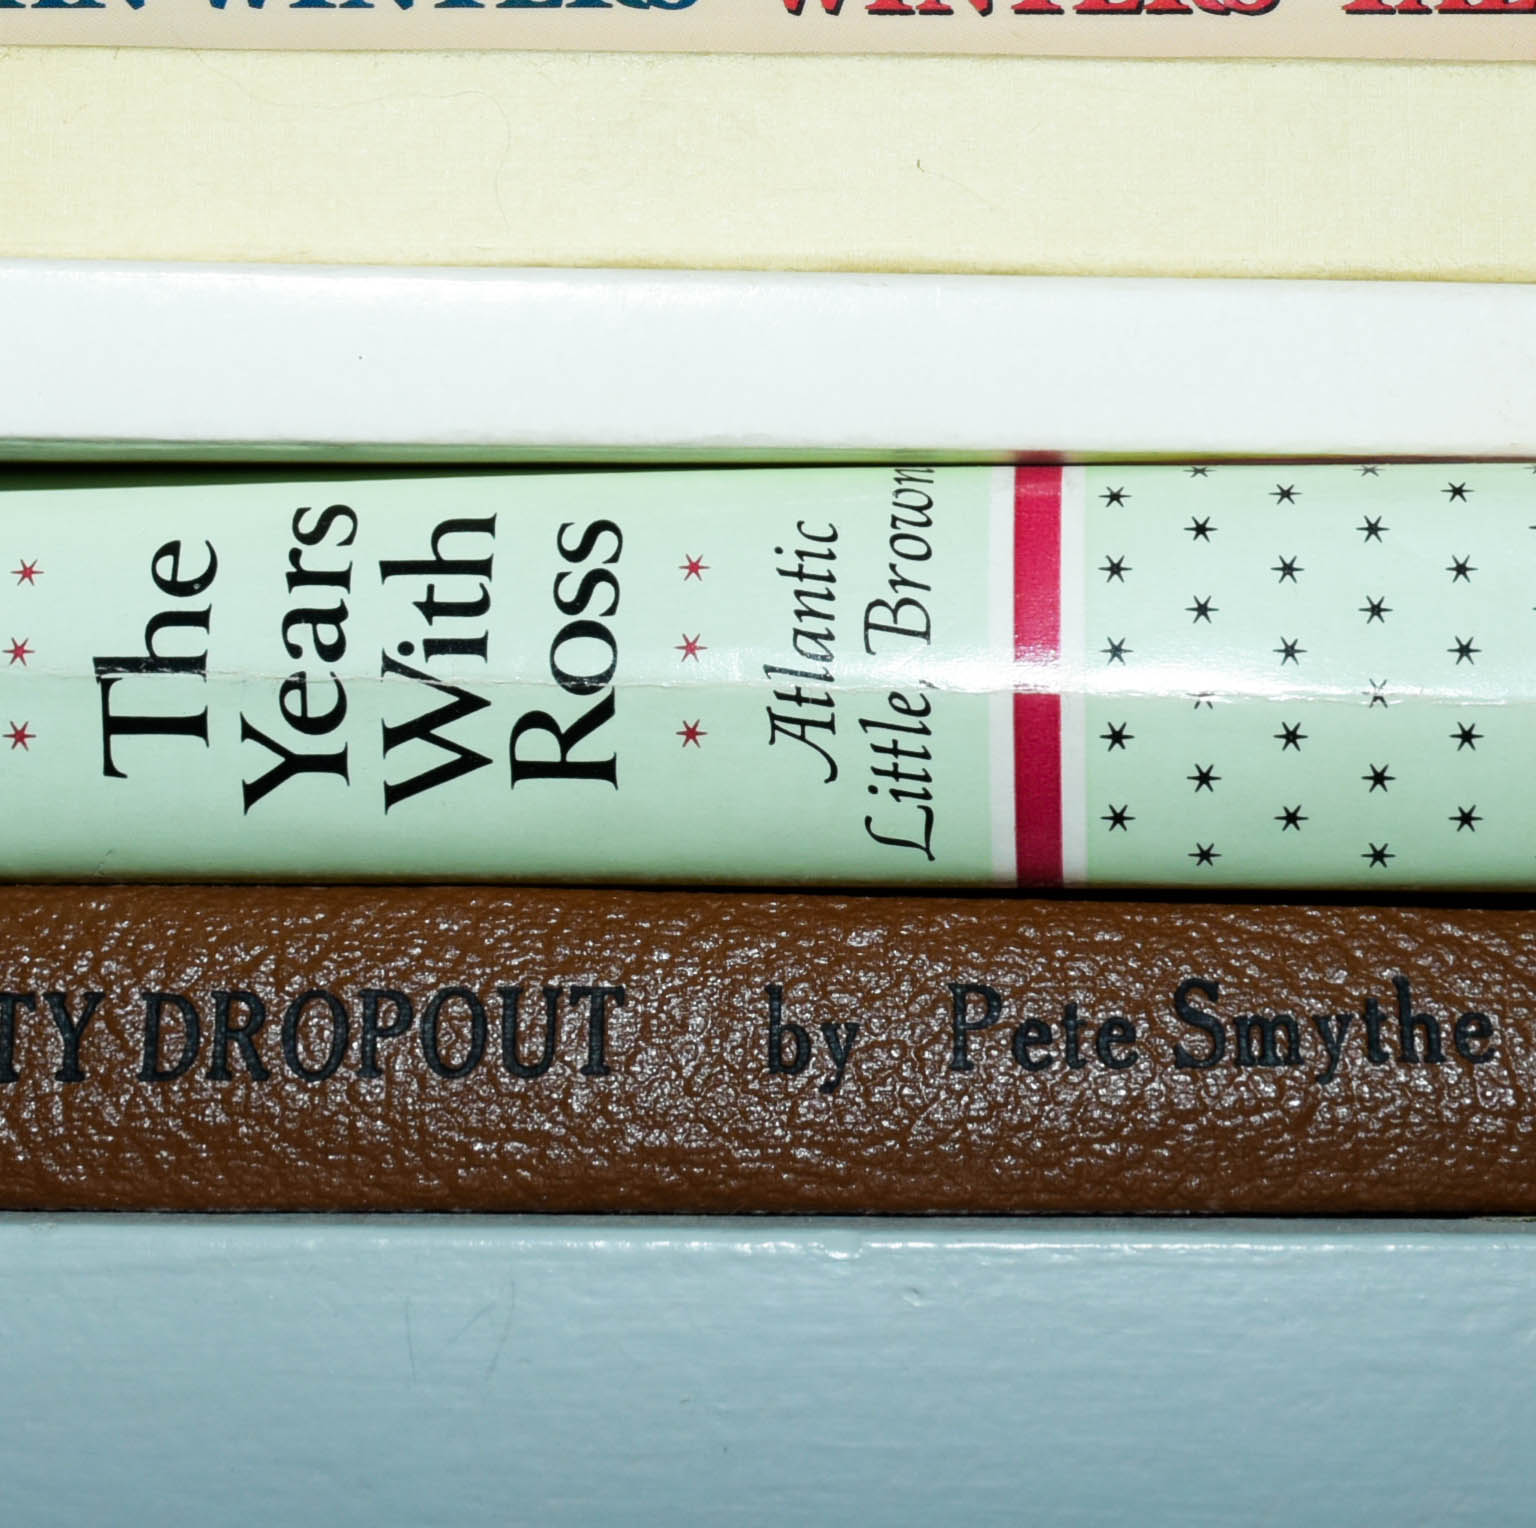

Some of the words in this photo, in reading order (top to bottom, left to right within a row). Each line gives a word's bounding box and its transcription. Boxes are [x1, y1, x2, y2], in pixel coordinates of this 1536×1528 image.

[92, 539, 219, 779] The
[240, 503, 358, 816] Years
[380, 512, 497, 815] With
[509, 519, 623, 791] Ross
[767, 519, 839, 784] Atlantic
[863, 465, 935, 656] Brown
[138, 983, 625, 1080] DROPOUT
[765, 983, 859, 1095] by
[948, 981, 1138, 1072] Pete
[1173, 976, 1495, 1085] Smythe
